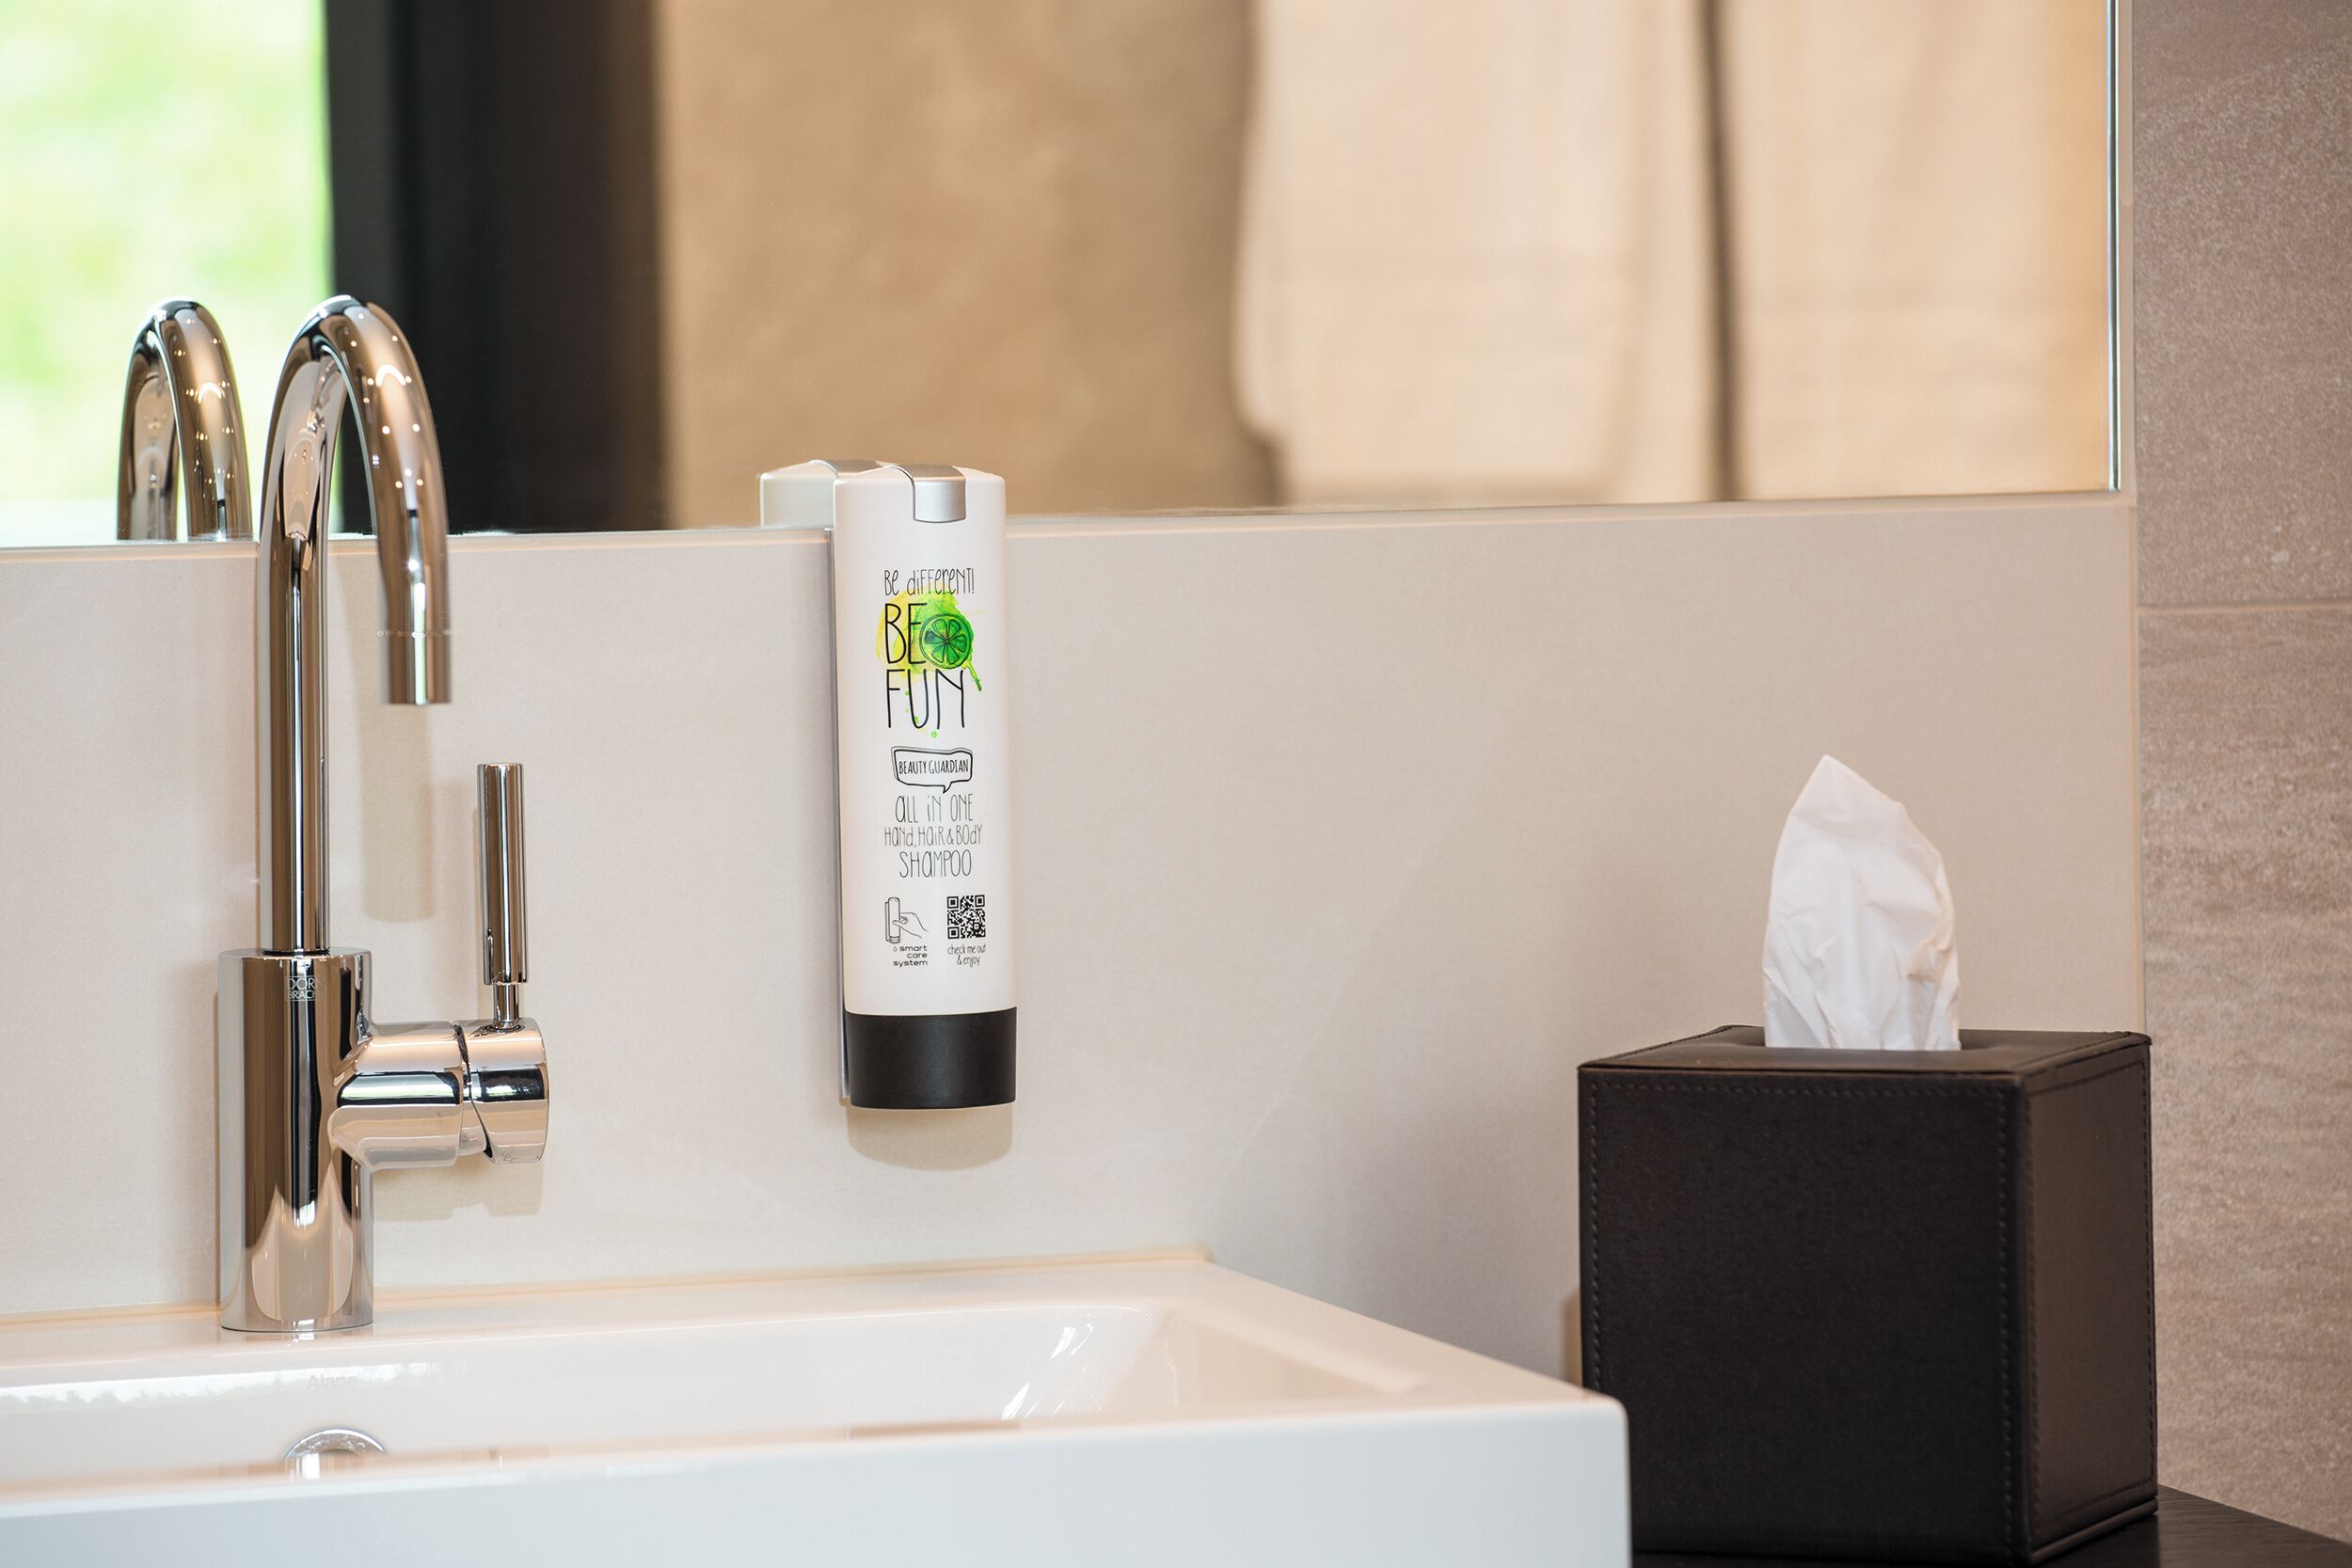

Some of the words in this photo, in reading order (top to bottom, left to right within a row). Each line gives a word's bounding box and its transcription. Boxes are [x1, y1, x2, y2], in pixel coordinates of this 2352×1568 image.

[884, 603, 928, 664] BE
[886, 669, 964, 729] FUN
[898, 760, 928, 774] BEAUTY
[929, 759, 968, 773] GUARDIAN
[950, 794, 973, 821] ONE
[946, 830, 955, 845] &
[947, 944, 966, 955] check
[977, 944, 986, 953] out
[957, 955, 962, 965] &
[963, 955, 980, 967] enjoy
[308, 1373, 358, 1391] Alape
